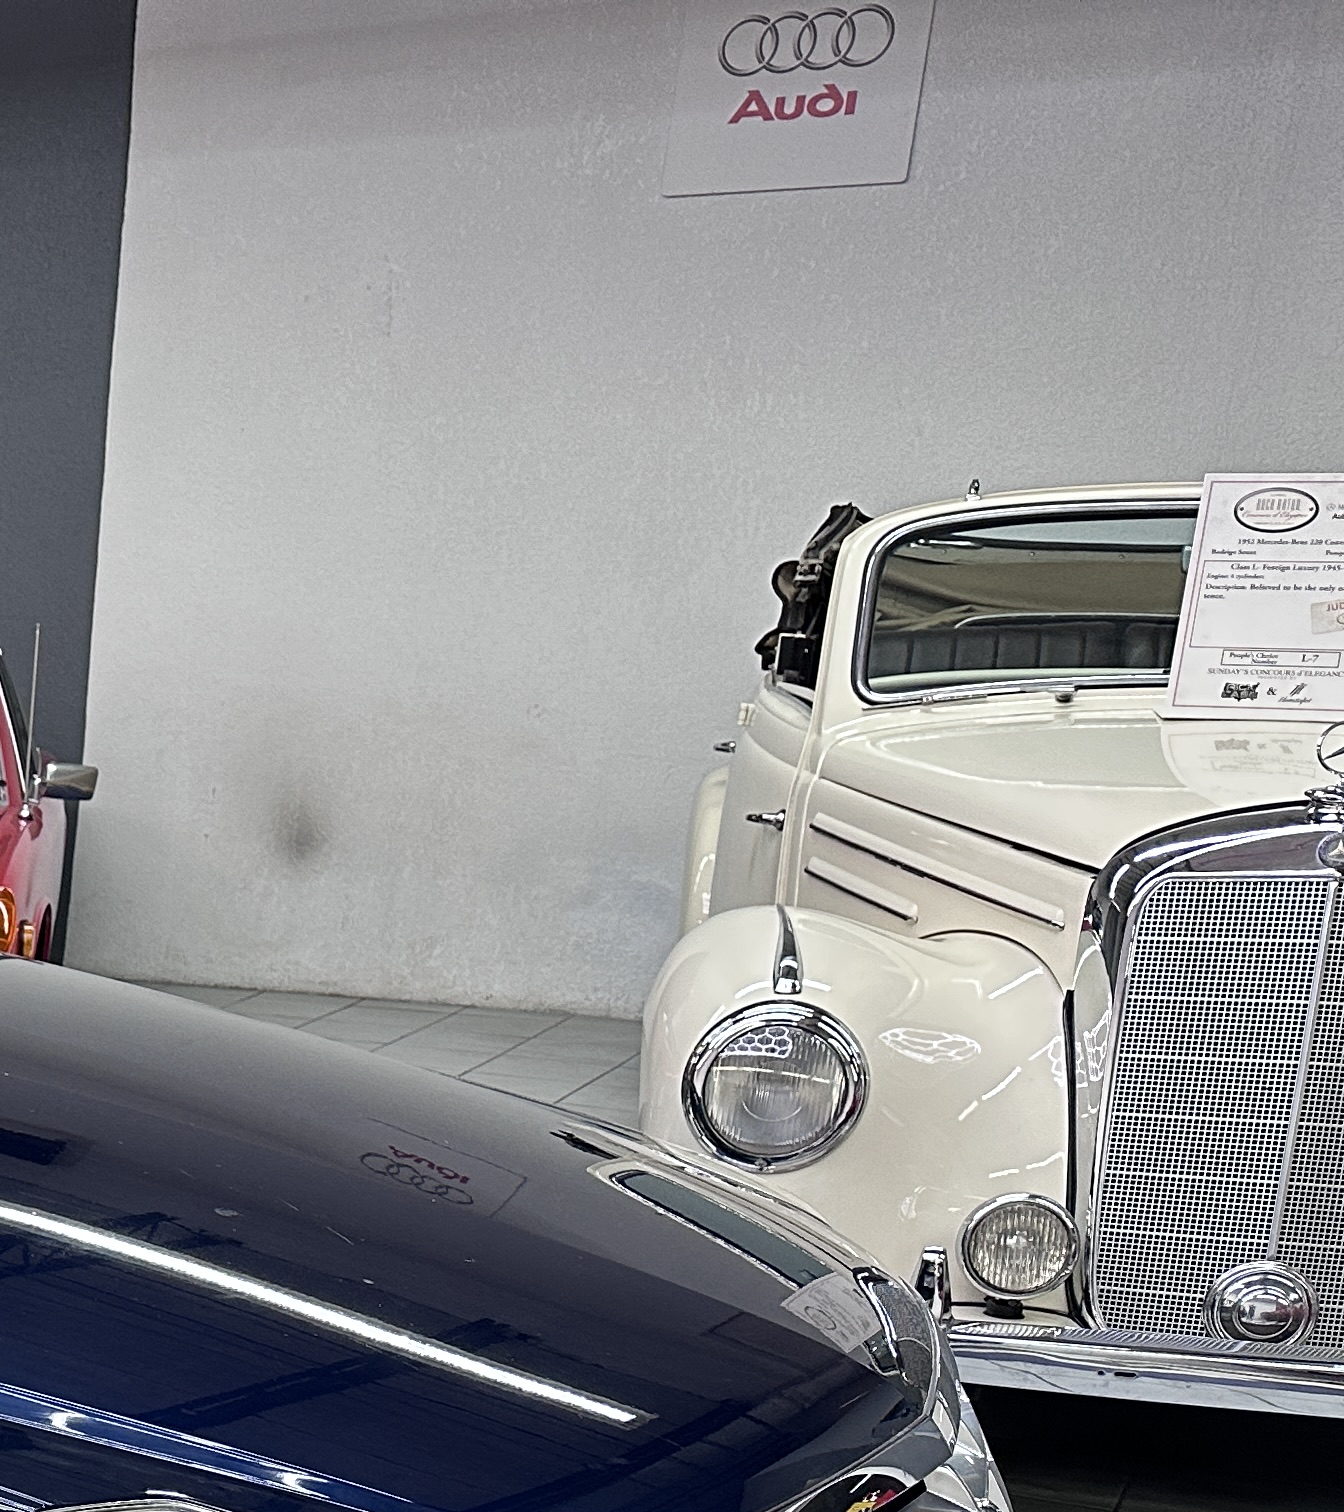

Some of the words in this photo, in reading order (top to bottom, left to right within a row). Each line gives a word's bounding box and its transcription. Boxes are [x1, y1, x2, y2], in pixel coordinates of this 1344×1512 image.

[727, 83, 858, 125] Audi
[1263, 564, 1291, 573] Foreign
[1318, 585, 1336, 593] only
